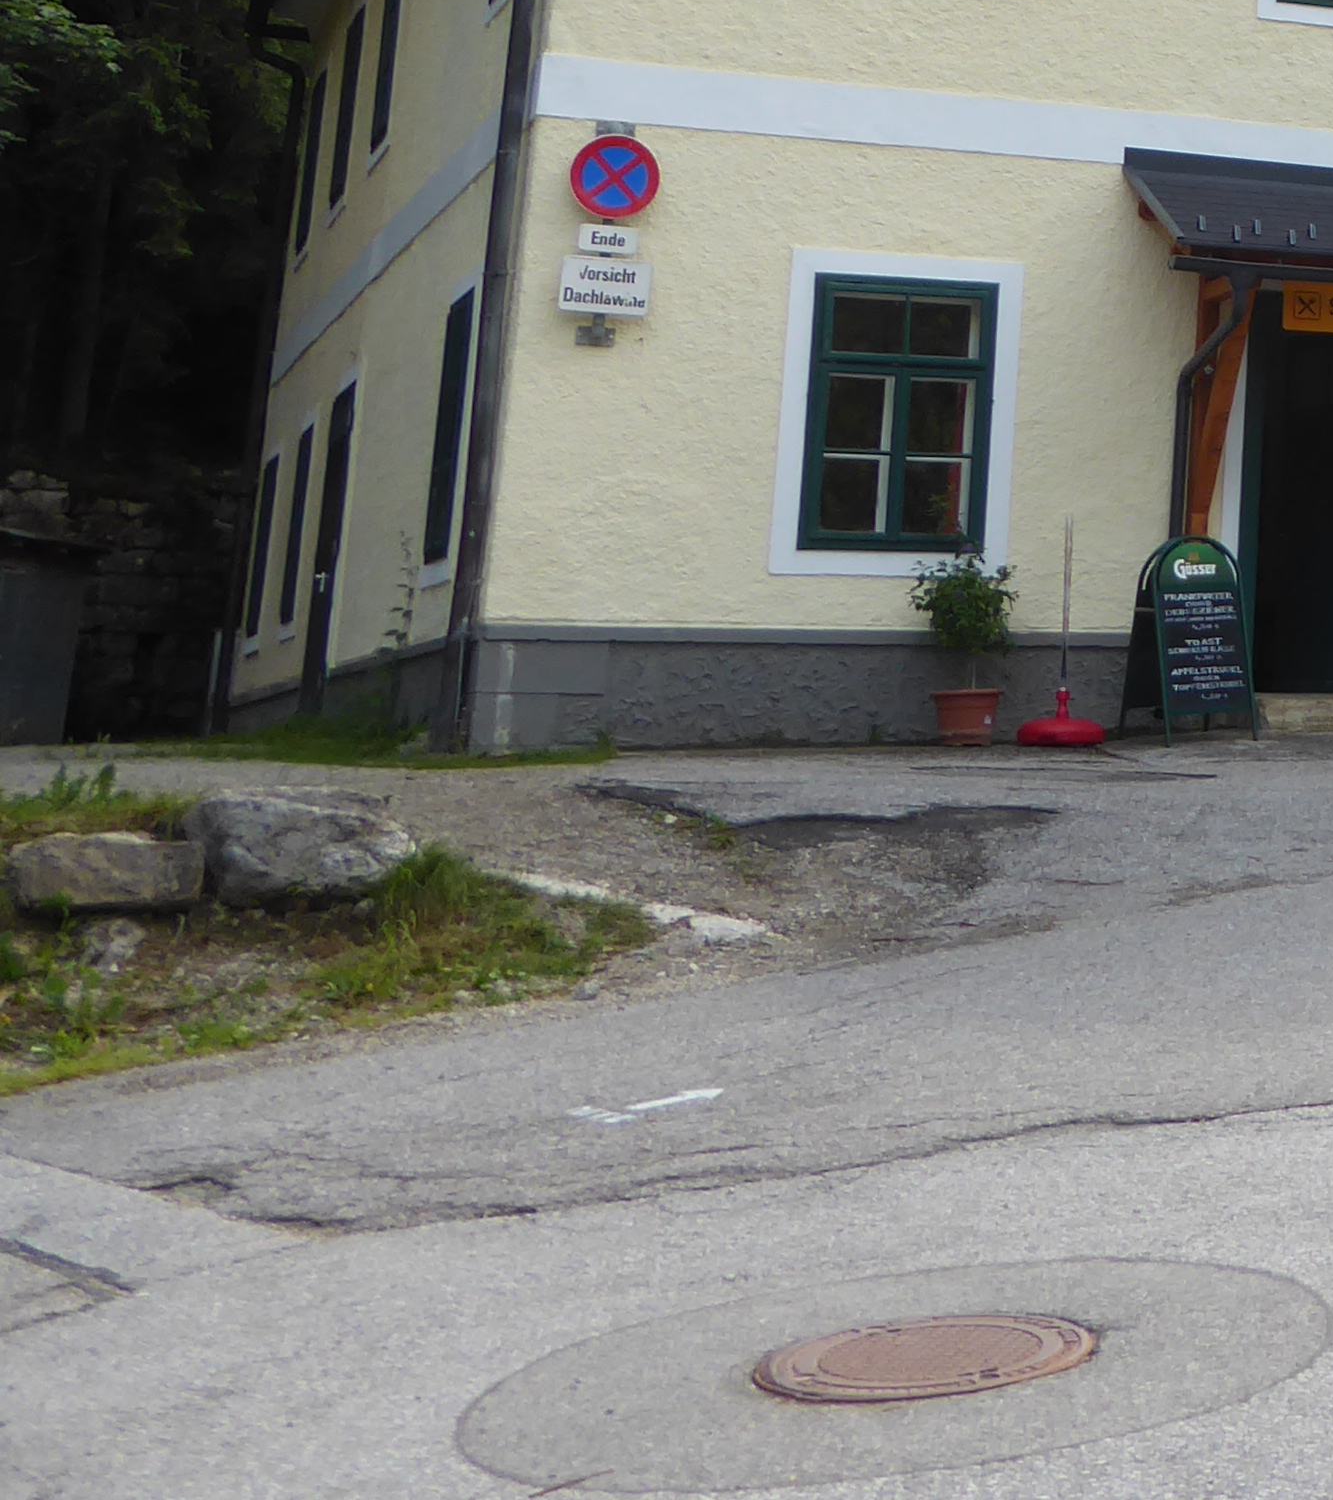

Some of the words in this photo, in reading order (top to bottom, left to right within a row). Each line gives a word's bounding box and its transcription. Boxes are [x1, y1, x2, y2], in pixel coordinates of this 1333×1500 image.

[590, 230, 626, 247] Ende
[579, 264, 637, 284] Vorsicht
[562, 286, 646, 308] Dachlawne
[1173, 558, 1217, 579] Gösser
[1184, 637, 1224, 646] TOAST
